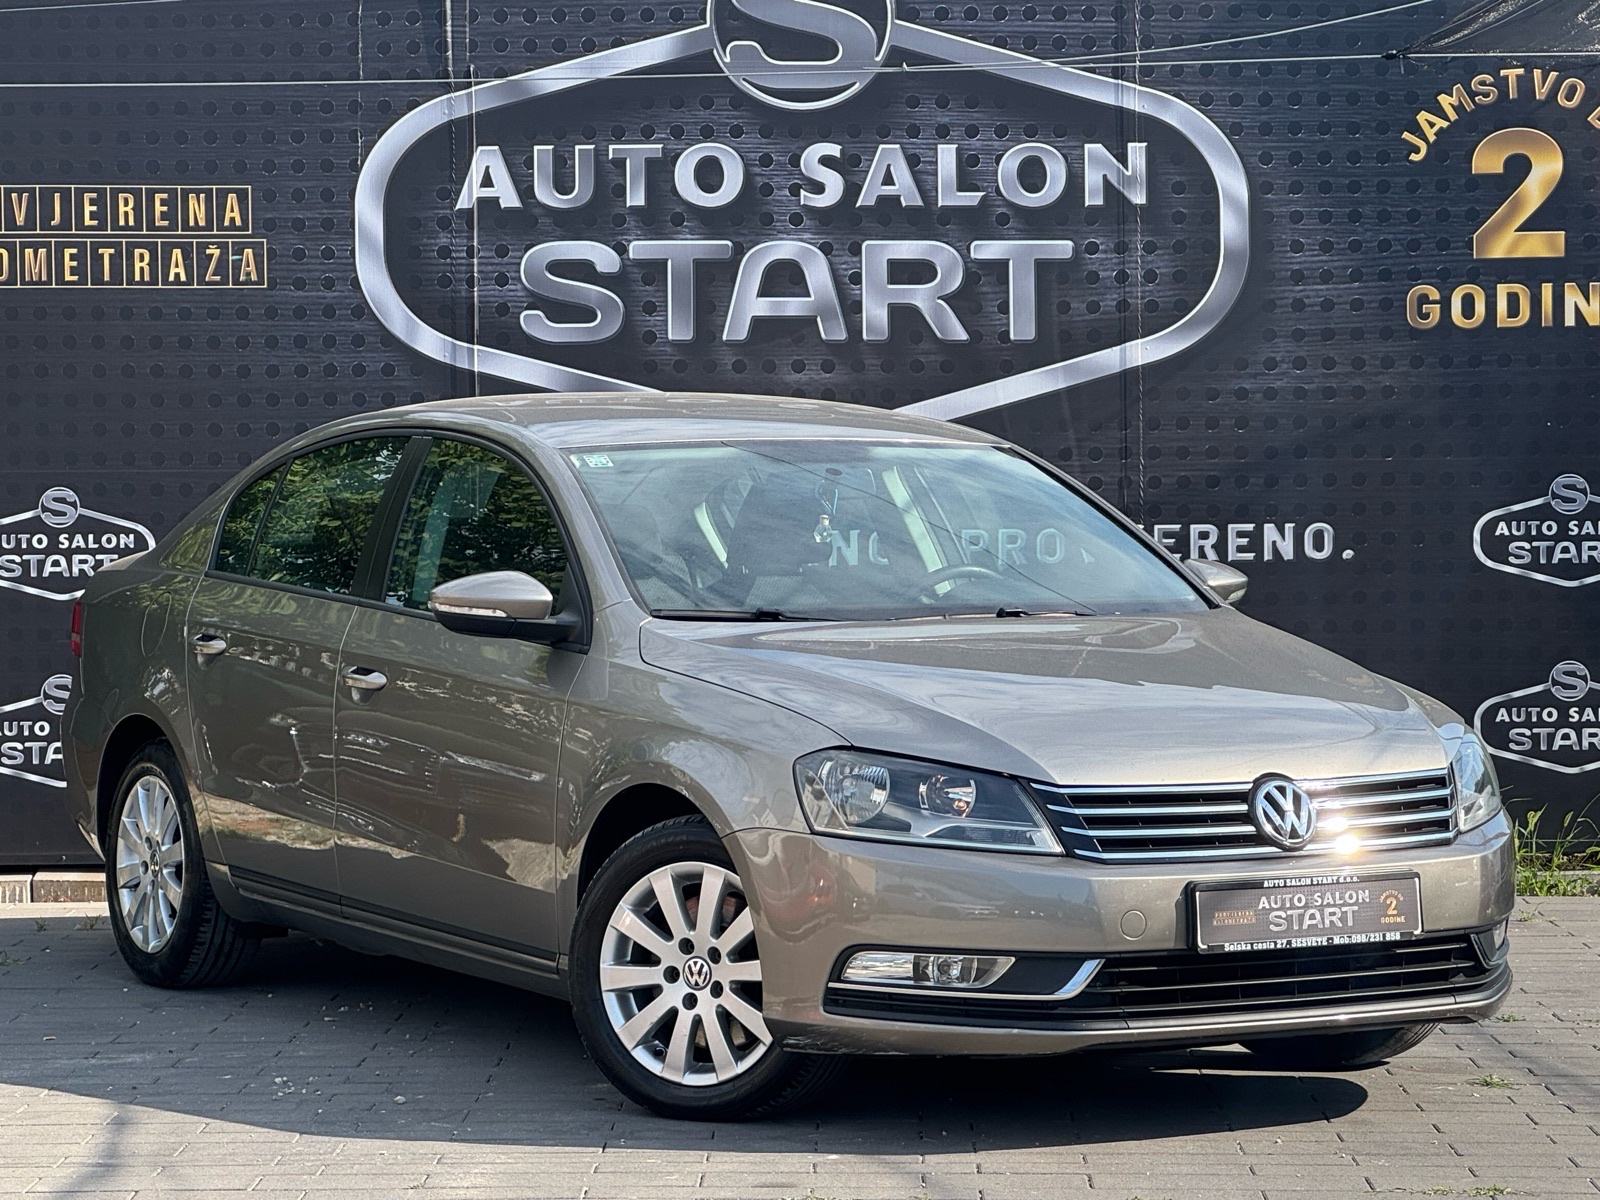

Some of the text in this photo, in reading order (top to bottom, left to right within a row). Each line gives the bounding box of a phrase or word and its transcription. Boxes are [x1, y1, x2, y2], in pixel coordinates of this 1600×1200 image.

[1401, 68, 1586, 162] JAMSTVO
[455, 142, 1148, 210] AUTO SALON
[1471, 127, 1566, 259] 2
[11, 192, 242, 226] VJERENA
[519, 241, 1075, 343] START
[1406, 282, 1600, 329] GODIN
[1495, 520, 1600, 536] AUTO SA
[1, 533, 135, 549] UTO SALON
[1508, 541, 1600, 564] STAR
[0, 554, 119, 578] START
[1495, 707, 1600, 722] AUTO SA
[0, 721, 50, 737] UTO
[1508, 728, 1600, 751] STAR
[1, 742, 63, 765] STA
[1263, 879, 1284, 888] AUTO
[1286, 878, 1311, 886] SALON
[1313, 876, 1337, 885] START
[1258, 890, 1370, 909] AUTO SALON
[1386, 897, 1398, 915] 2
[1269, 906, 1359, 932] START
[1224, 942, 1252, 952] Selska
[1276, 939, 1290, 949] 27.
[1291, 937, 1328, 948] SESVETE
